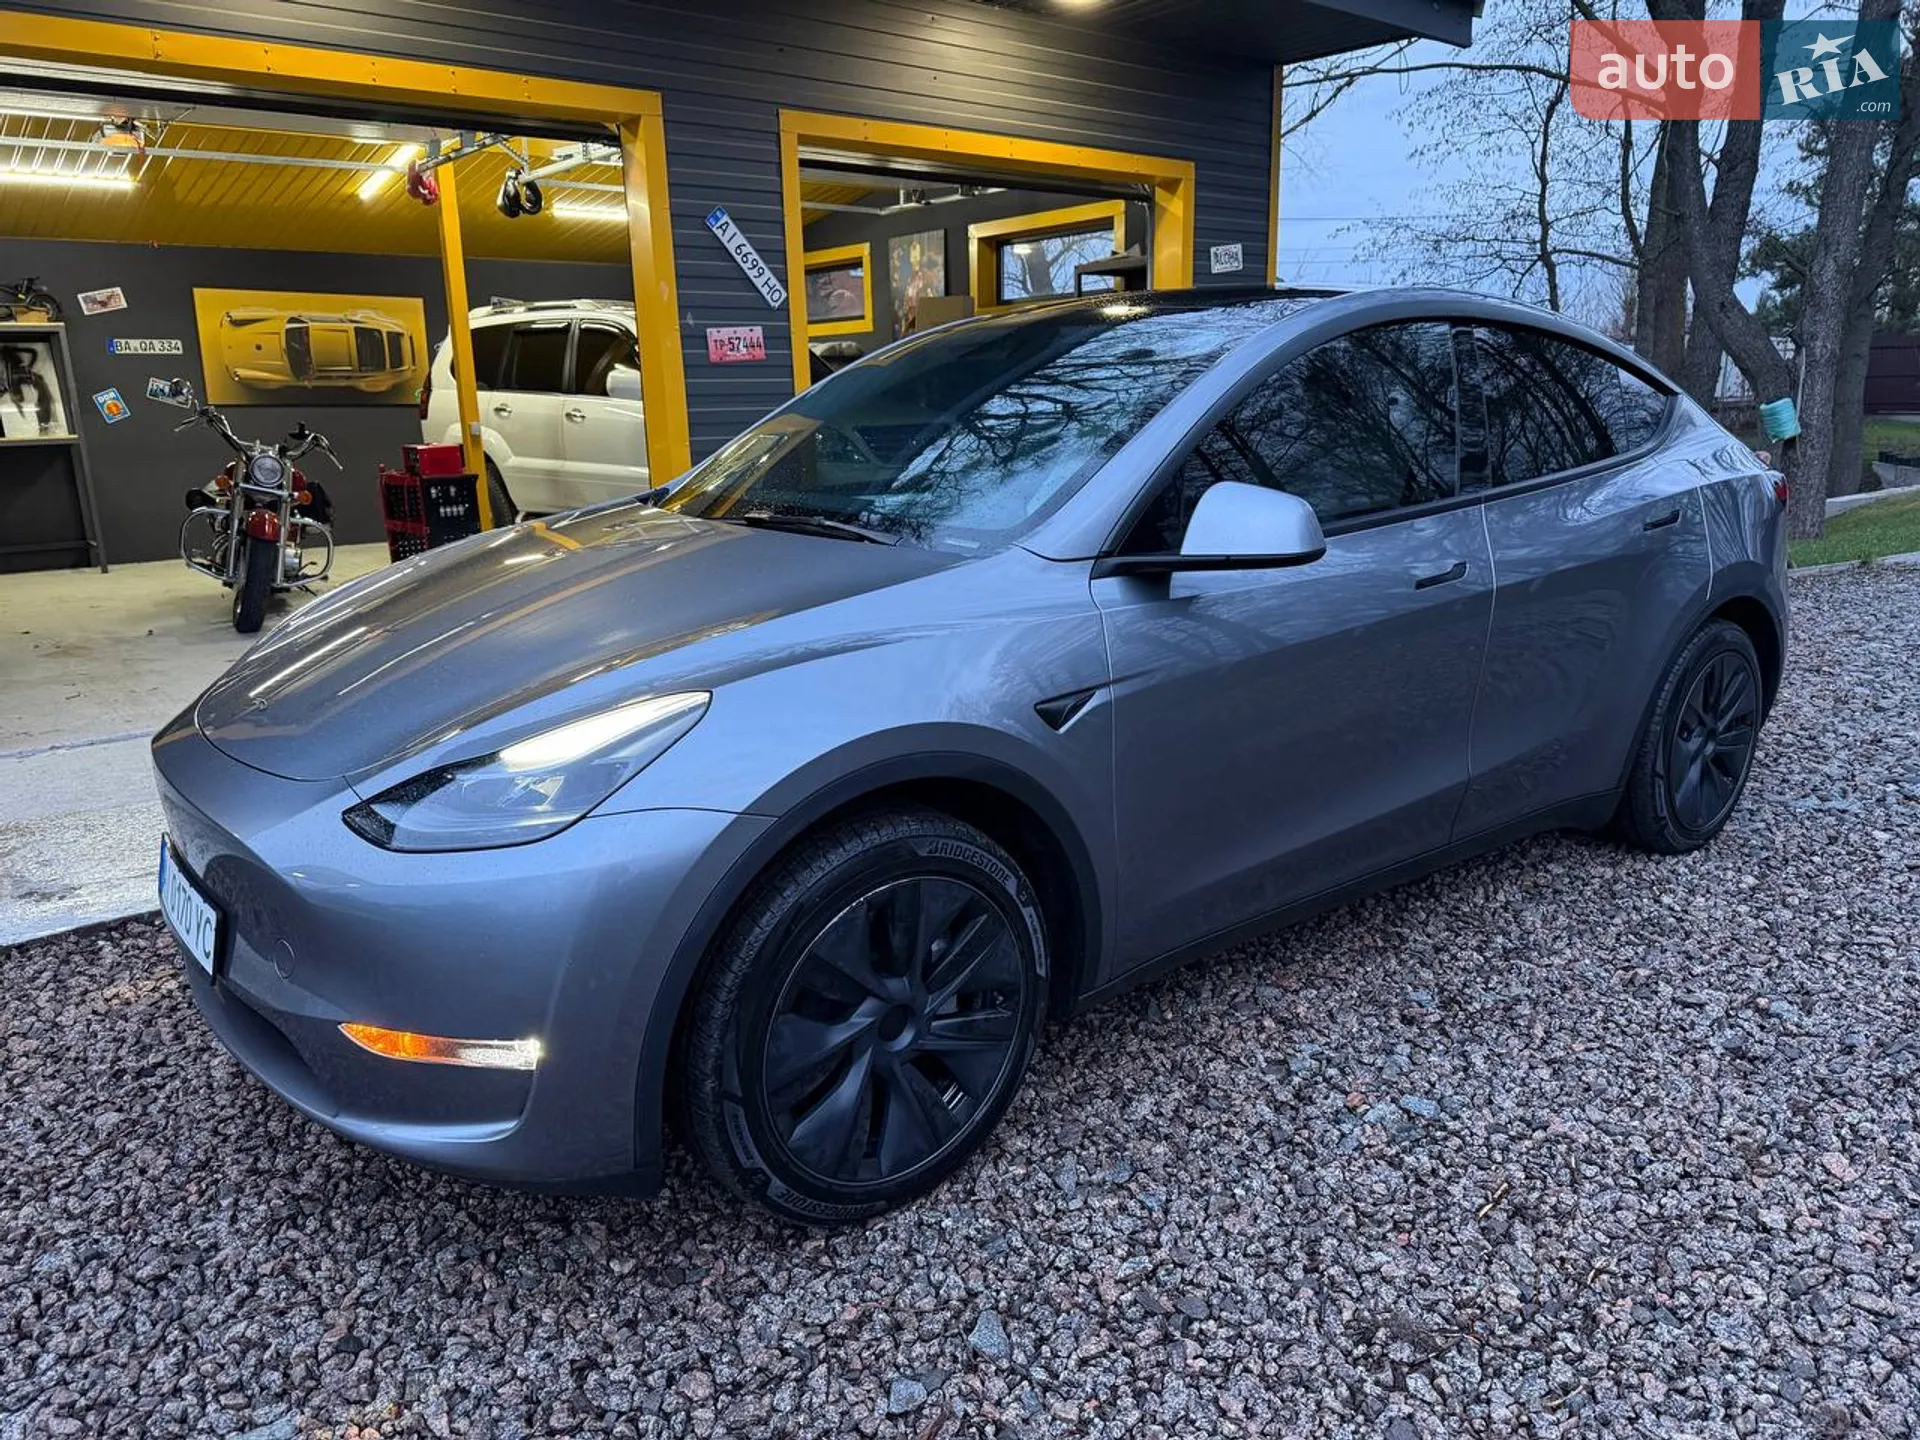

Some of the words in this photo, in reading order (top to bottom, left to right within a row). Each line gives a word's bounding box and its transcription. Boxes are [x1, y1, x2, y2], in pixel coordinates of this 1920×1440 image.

[734, 243, 765, 280] 6699
[761, 277, 782, 303] HO
[115, 340, 132, 352] BA
[158, 340, 181, 352] 334
[929, 839, 1011, 887] BRIDGESTONE
